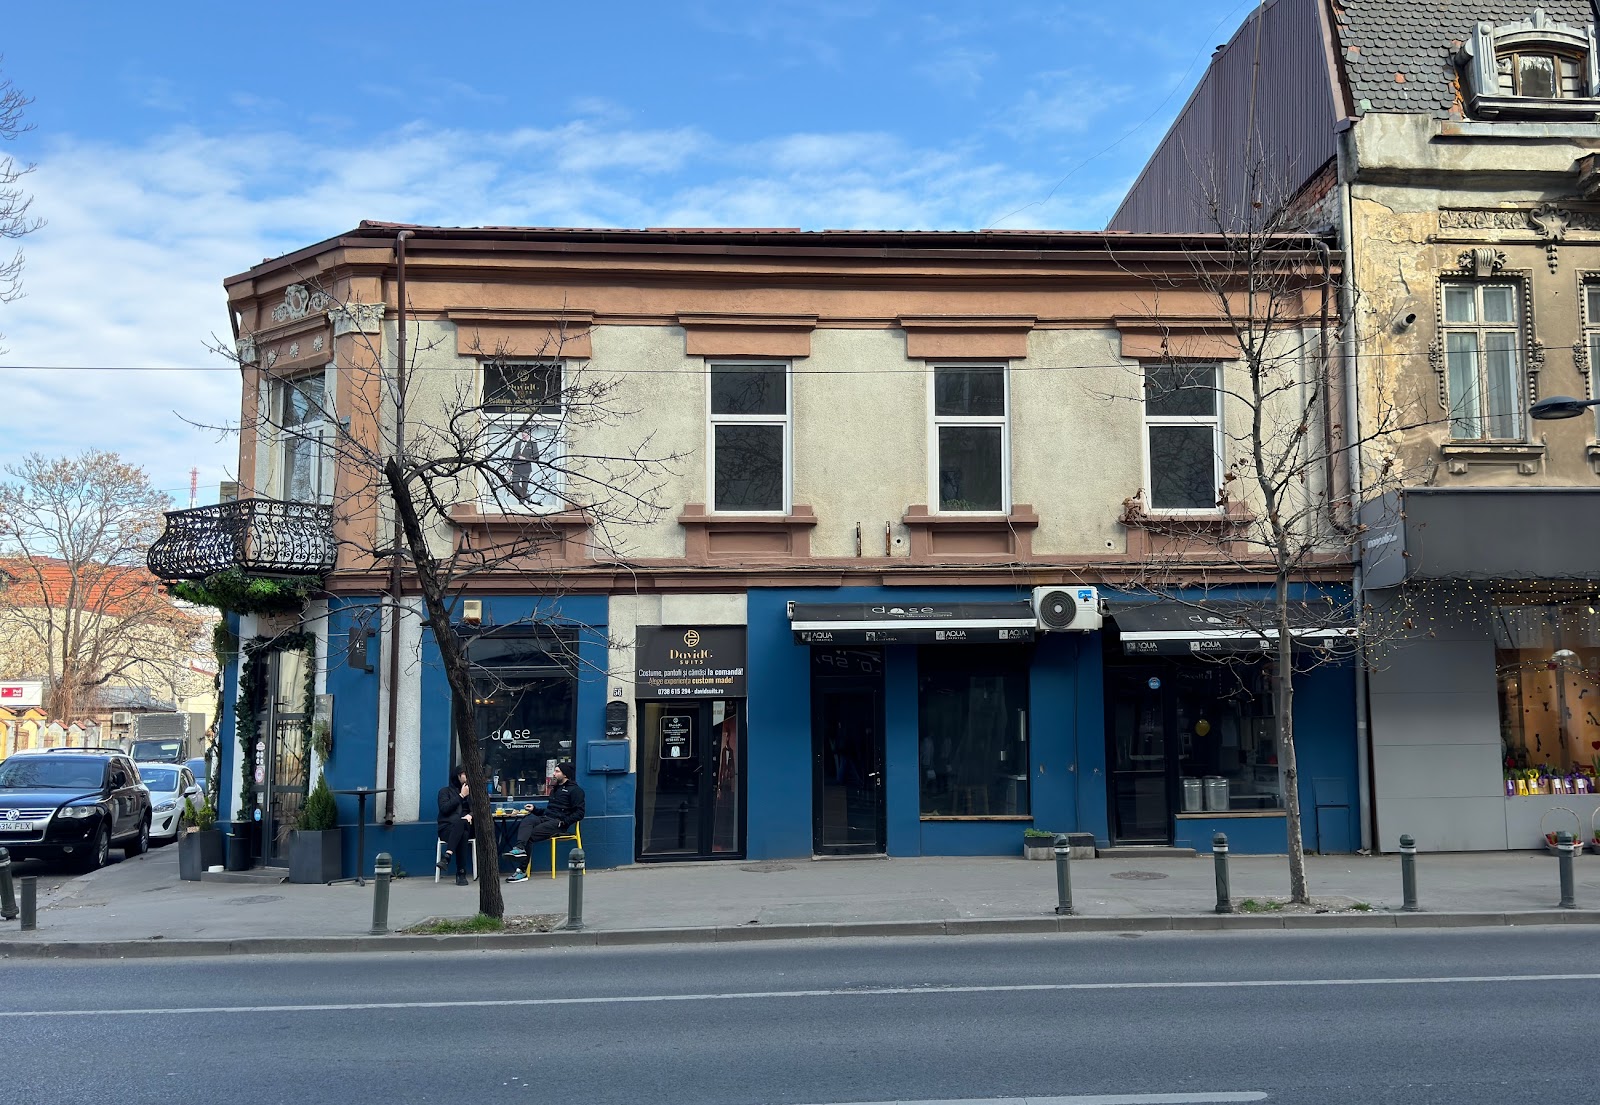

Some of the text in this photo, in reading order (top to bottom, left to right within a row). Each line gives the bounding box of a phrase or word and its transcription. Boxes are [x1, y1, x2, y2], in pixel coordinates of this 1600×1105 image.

[708, 668, 714, 676] la
[692, 676, 714, 684] custom
[715, 676, 734, 684] made!
